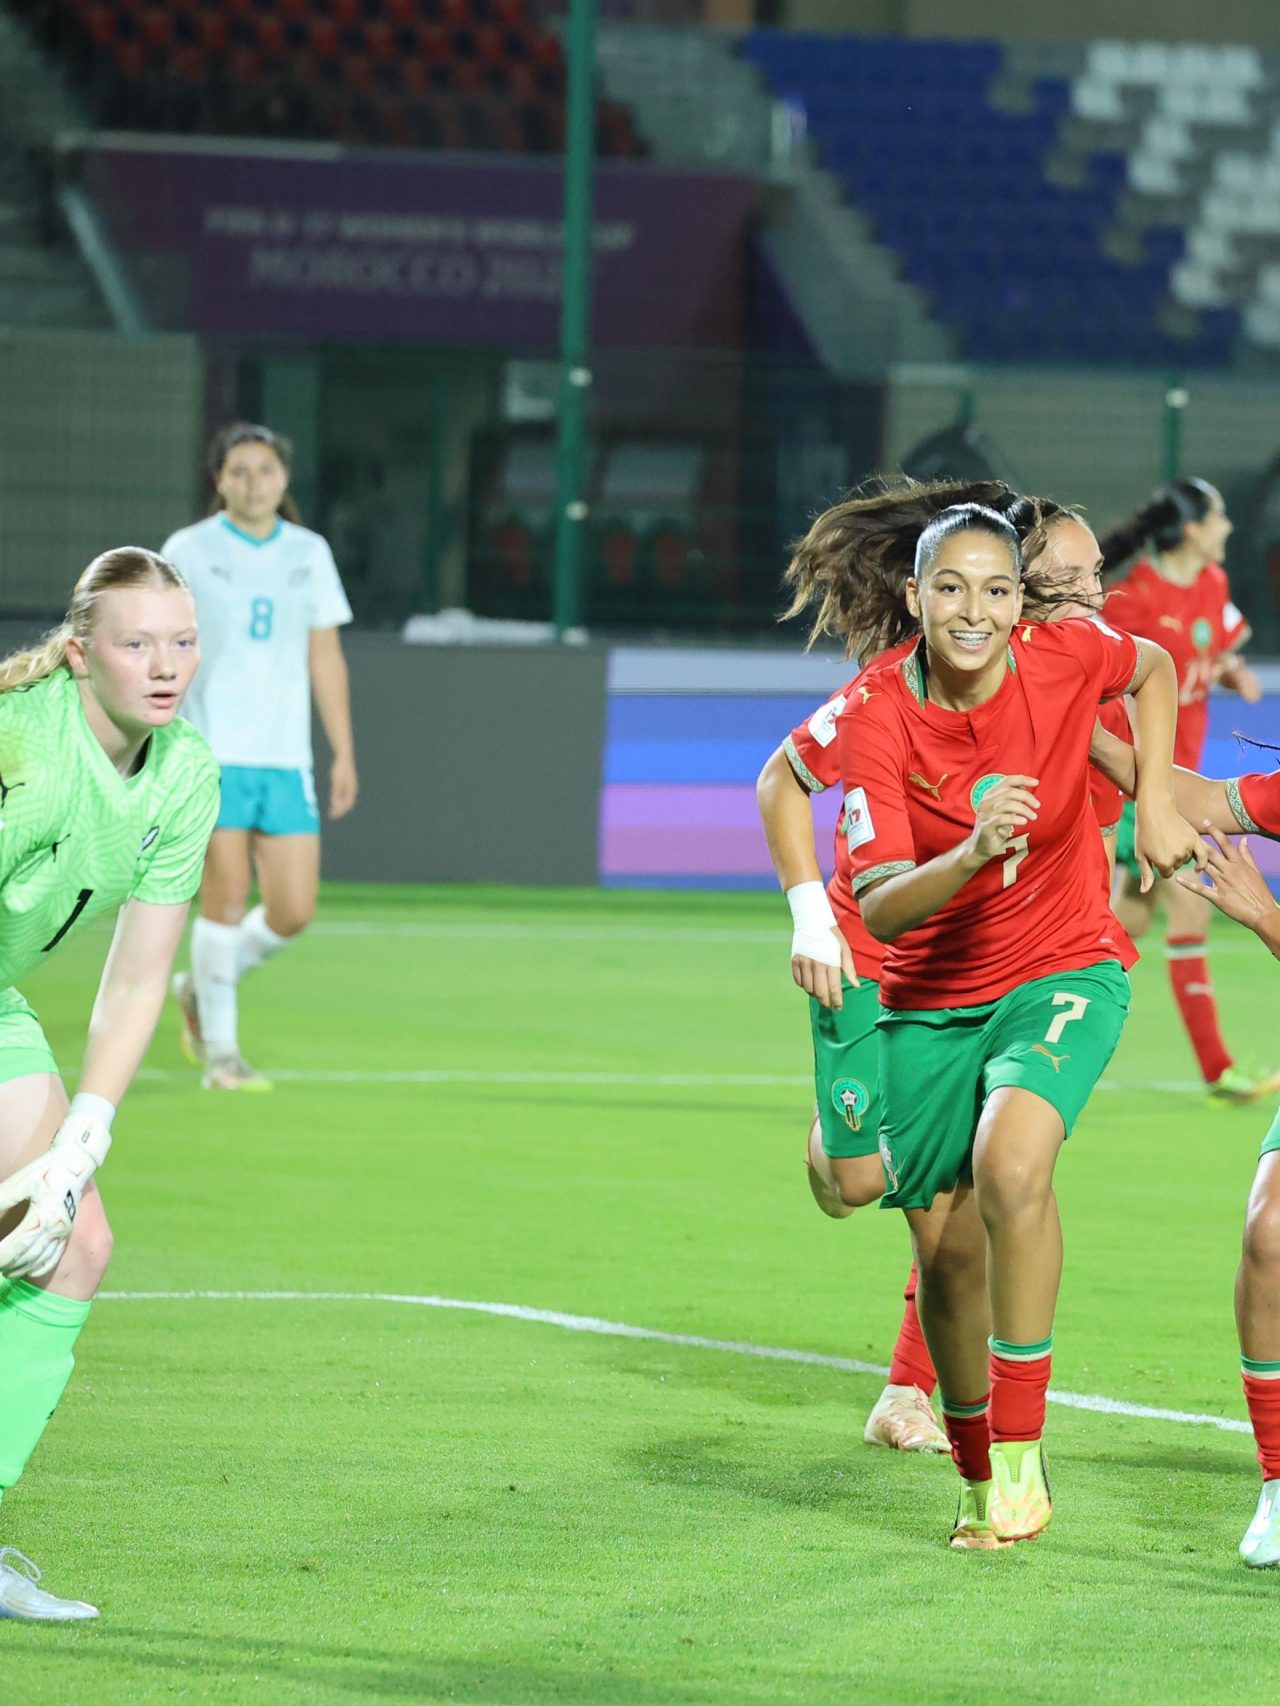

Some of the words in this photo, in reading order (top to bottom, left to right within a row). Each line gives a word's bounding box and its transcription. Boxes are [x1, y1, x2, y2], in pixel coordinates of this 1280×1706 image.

[249, 243, 479, 298] MOROCCO
[481, 252, 564, 304] 202
[250, 597, 274, 641] 8
[1000, 832, 1031, 890] 7
[40, 887, 95, 952] 1
[1043, 991, 1093, 1044] 7
